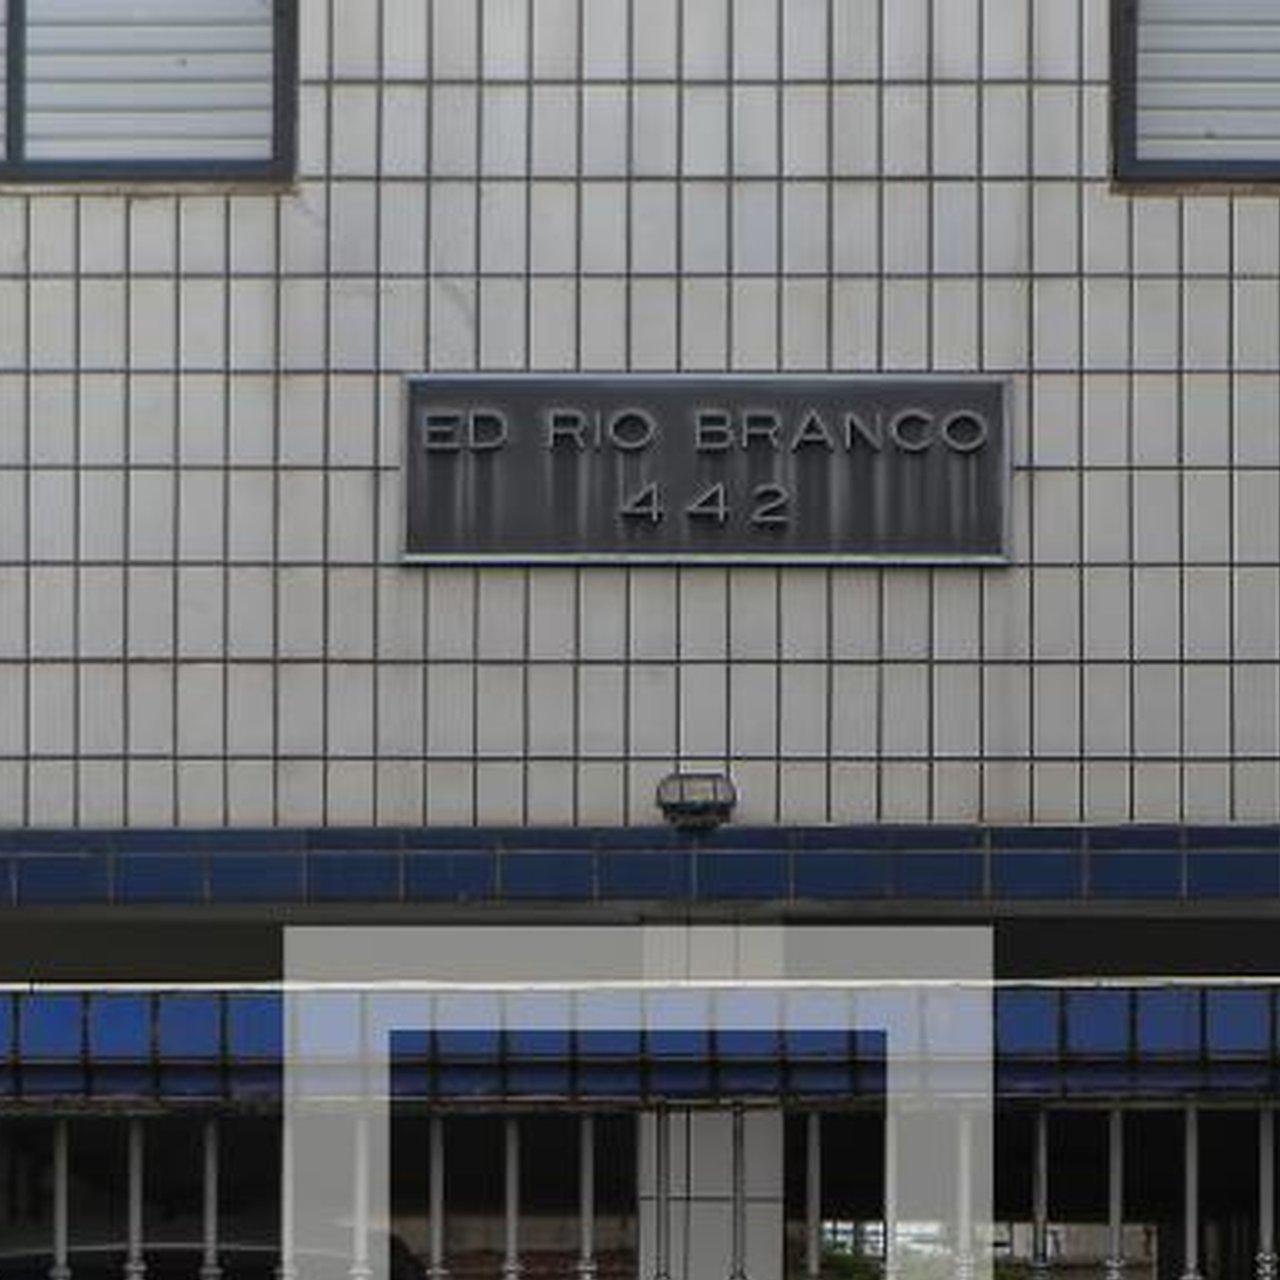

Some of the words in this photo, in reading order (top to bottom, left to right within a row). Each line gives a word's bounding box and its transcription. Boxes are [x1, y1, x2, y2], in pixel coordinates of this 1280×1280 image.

[423, 407, 508, 450] ED
[547, 407, 658, 450] RIO
[694, 407, 990, 452] BRANCO
[620, 482, 795, 524] 442
